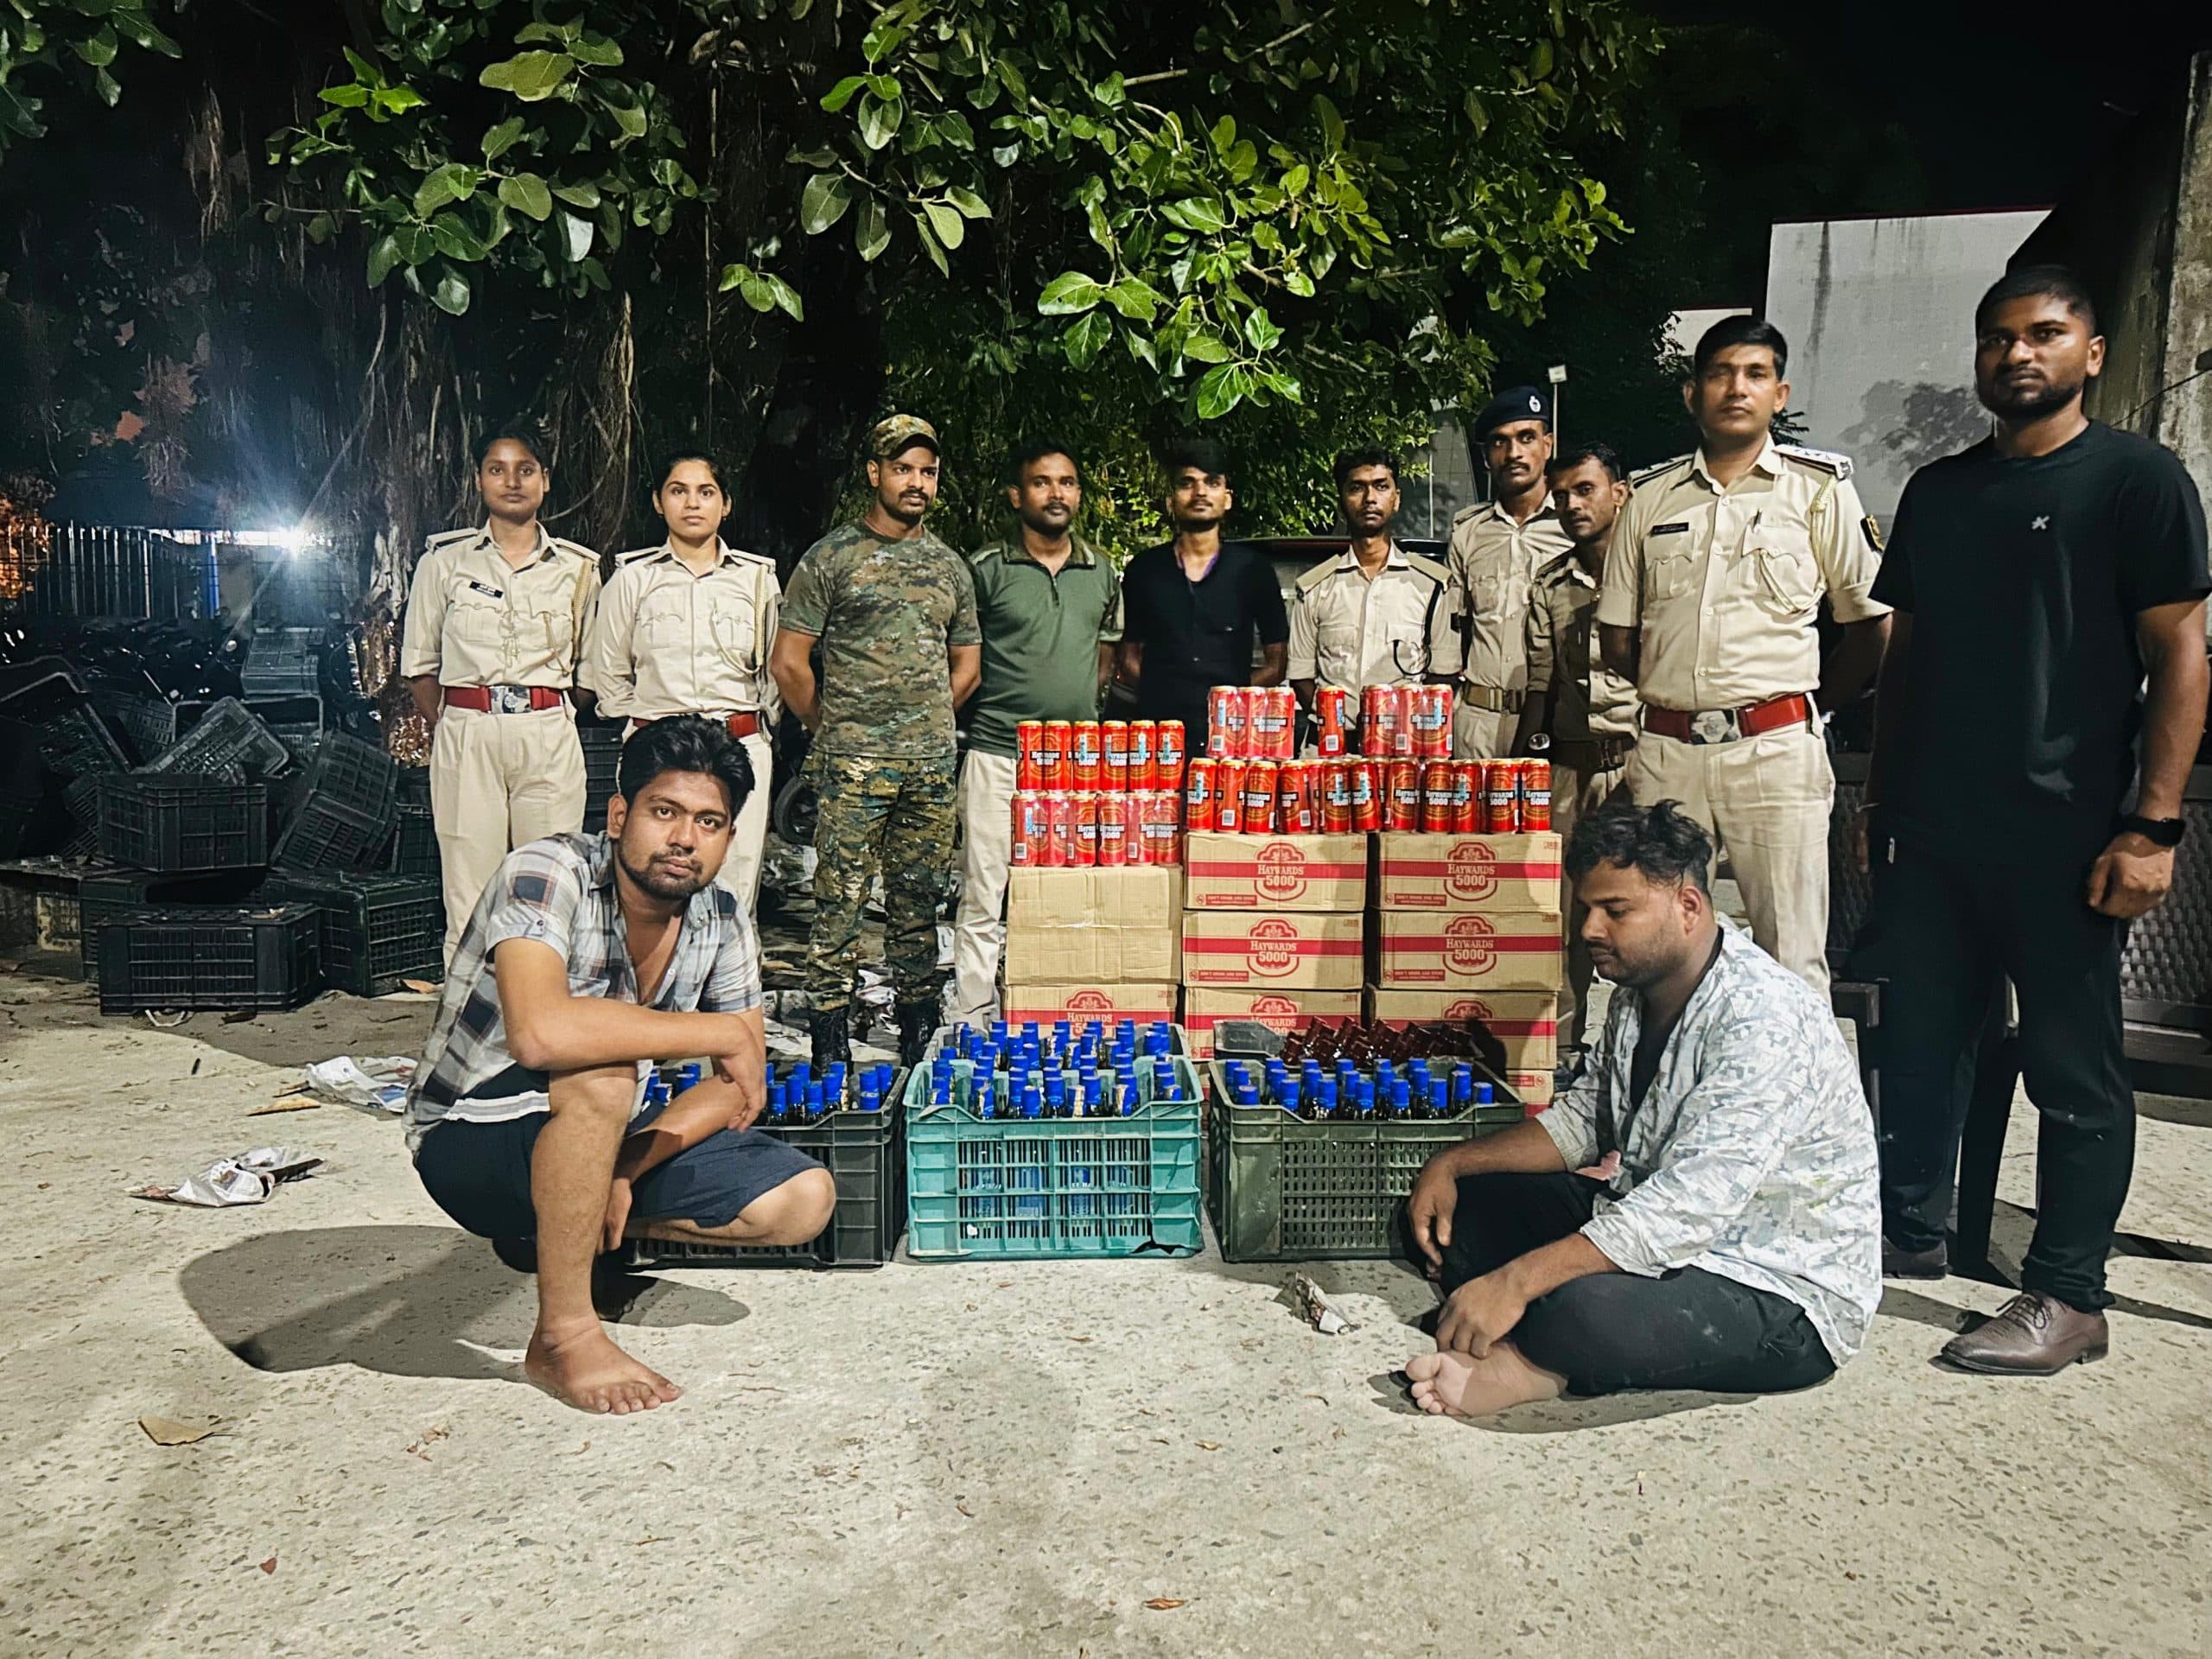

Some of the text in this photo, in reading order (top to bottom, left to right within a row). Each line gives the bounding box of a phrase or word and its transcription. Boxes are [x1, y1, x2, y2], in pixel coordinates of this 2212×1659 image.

[1257, 864, 1304, 875] HAYWARDS
[1447, 864, 1495, 874] HAYWARDS
[1266, 875, 1295, 887] 5000
[1456, 874, 1486, 886] 5000
[1250, 941, 1297, 951] HAYWARDS
[1446, 938, 1494, 949] HAYWARDS
[1258, 951, 1288, 963] 5000
[1454, 949, 1485, 960] 5000
[1067, 1013, 1113, 1023] HAYWARDS
